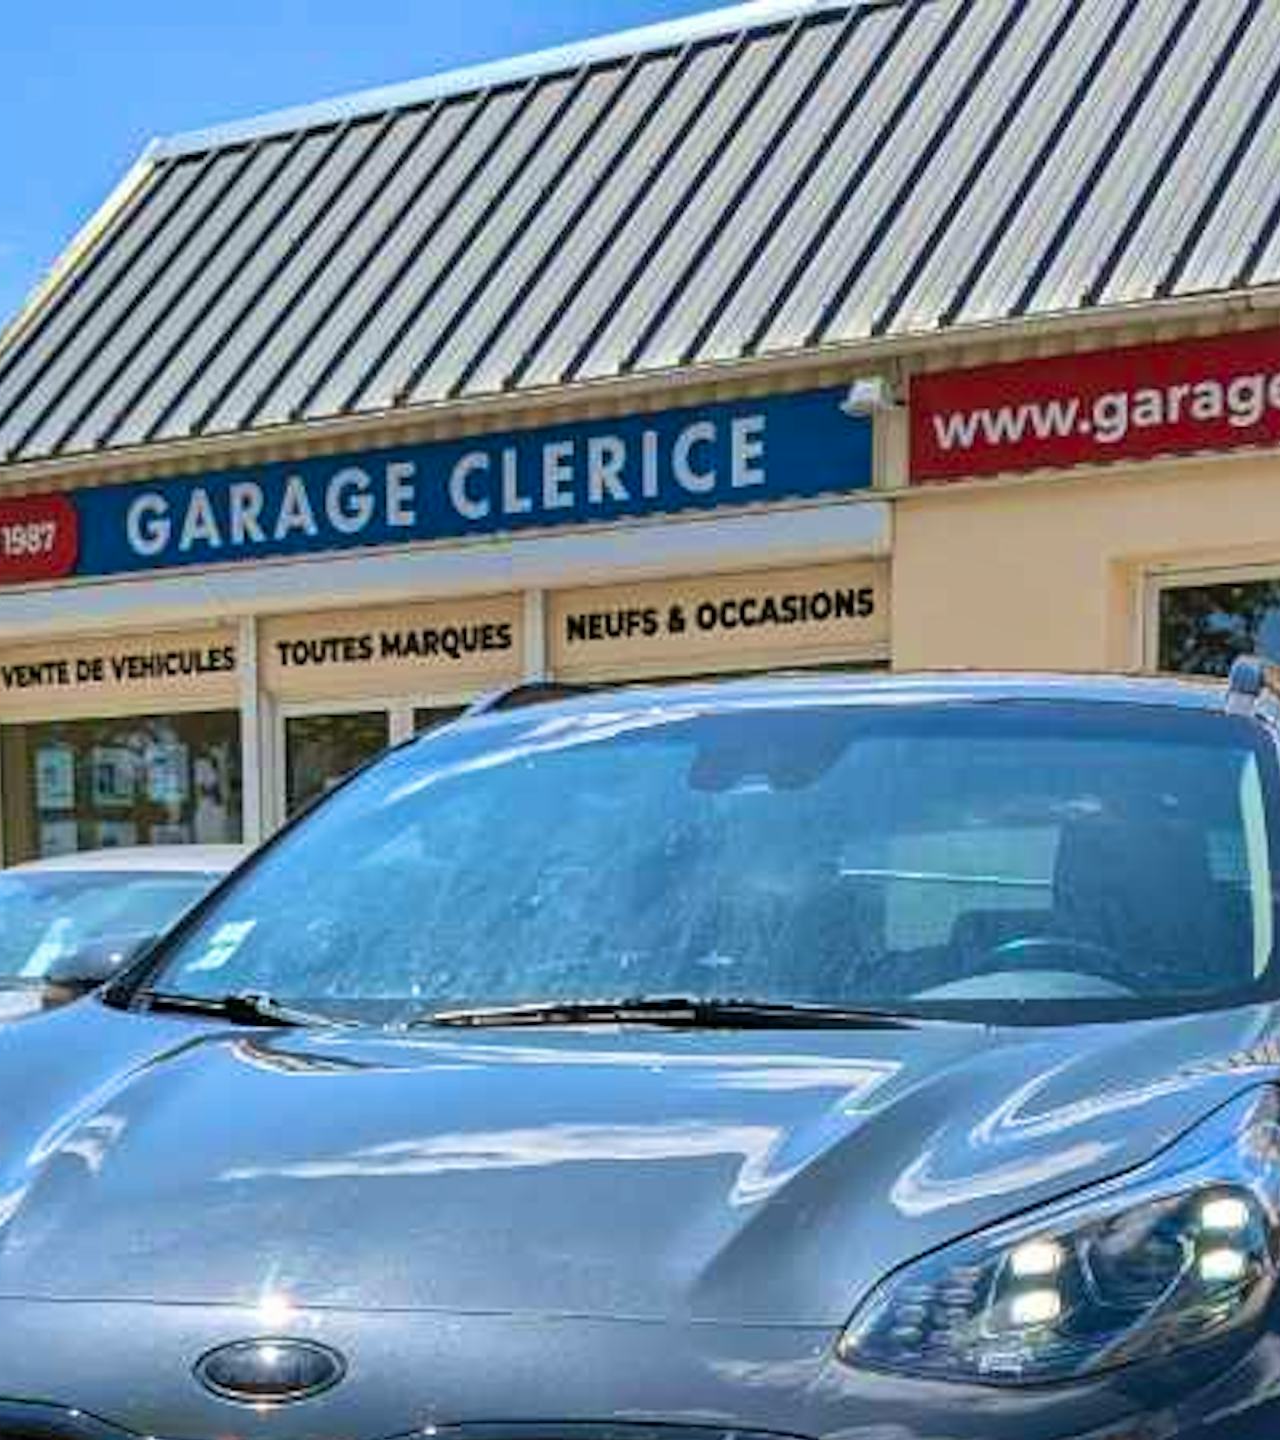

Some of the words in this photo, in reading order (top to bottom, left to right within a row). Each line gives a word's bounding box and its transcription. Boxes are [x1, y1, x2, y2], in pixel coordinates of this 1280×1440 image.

[127, 463, 416, 555] GARAGE
[449, 415, 767, 519] CLERICE
[1, 521, 57, 555] 1987
[567, 609, 657, 641] NEUFS
[668, 606, 685, 633] &
[697, 588, 874, 630] OCCASIONS
[278, 637, 372, 666] TOUTES
[381, 624, 511, 659] MARQUES
[1, 660, 70, 690] VENTE
[77, 656, 103, 681] DE
[110, 646, 235, 679] VEHICULES
